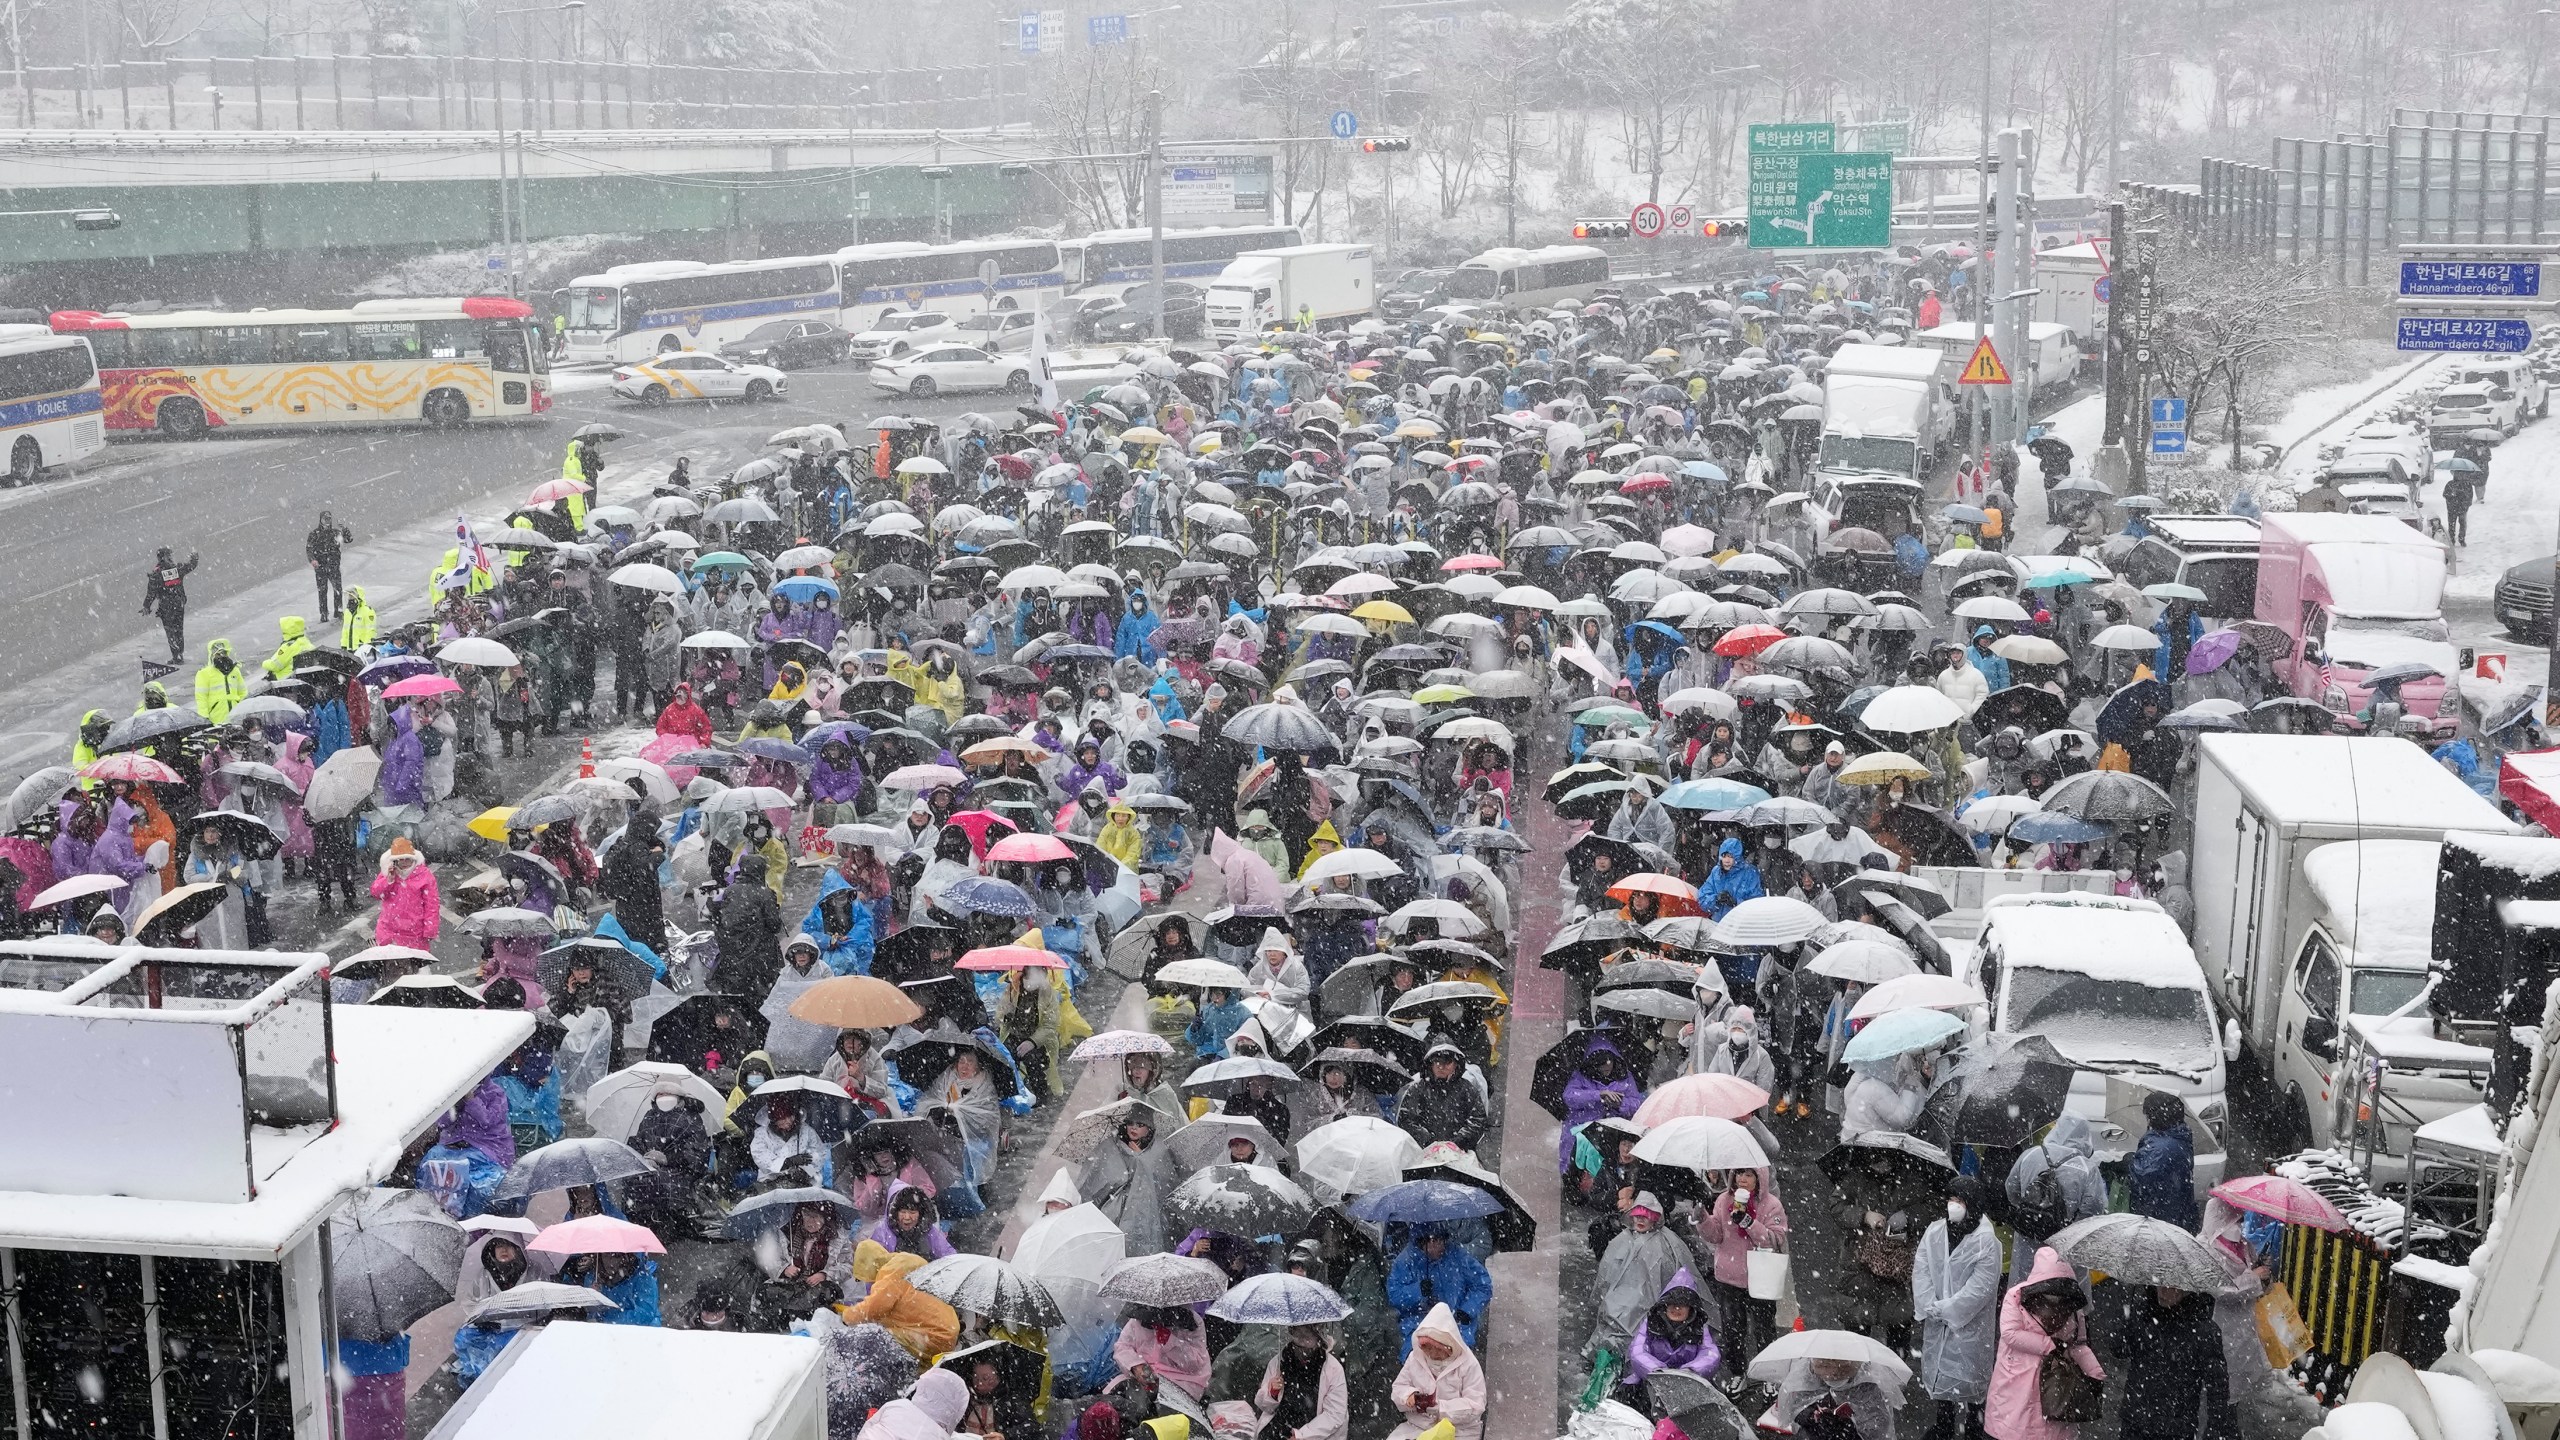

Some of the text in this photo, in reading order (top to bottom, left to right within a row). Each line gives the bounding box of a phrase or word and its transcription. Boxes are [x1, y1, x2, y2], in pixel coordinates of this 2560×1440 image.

[1752, 156, 1799, 169] 용산구청
[1833, 167, 1890, 180] 장충체육관
[1752, 181, 1798, 194] 이태원역
[1832, 193, 1869, 206] 약수역
[1751, 208, 1798, 216] Itaewon Stn
[1809, 204, 1821, 212] 41
[1832, 207, 1872, 216] Yaksu Stn
[1638, 212, 1658, 229] 50
[1674, 212, 1687, 222] 60
[2416, 264, 2512, 281] 한남대로46길
[1016, 278, 1039, 287] POLICE
[2409, 283, 2515, 295] Hannam-daero 46-gil
[793, 298, 815, 308] POLICE
[2402, 320, 2498, 337] 한남대로42길
[2400, 338, 2513, 351] Hannam-daero 42-gil
[37, 399, 68, 416] POLICE
